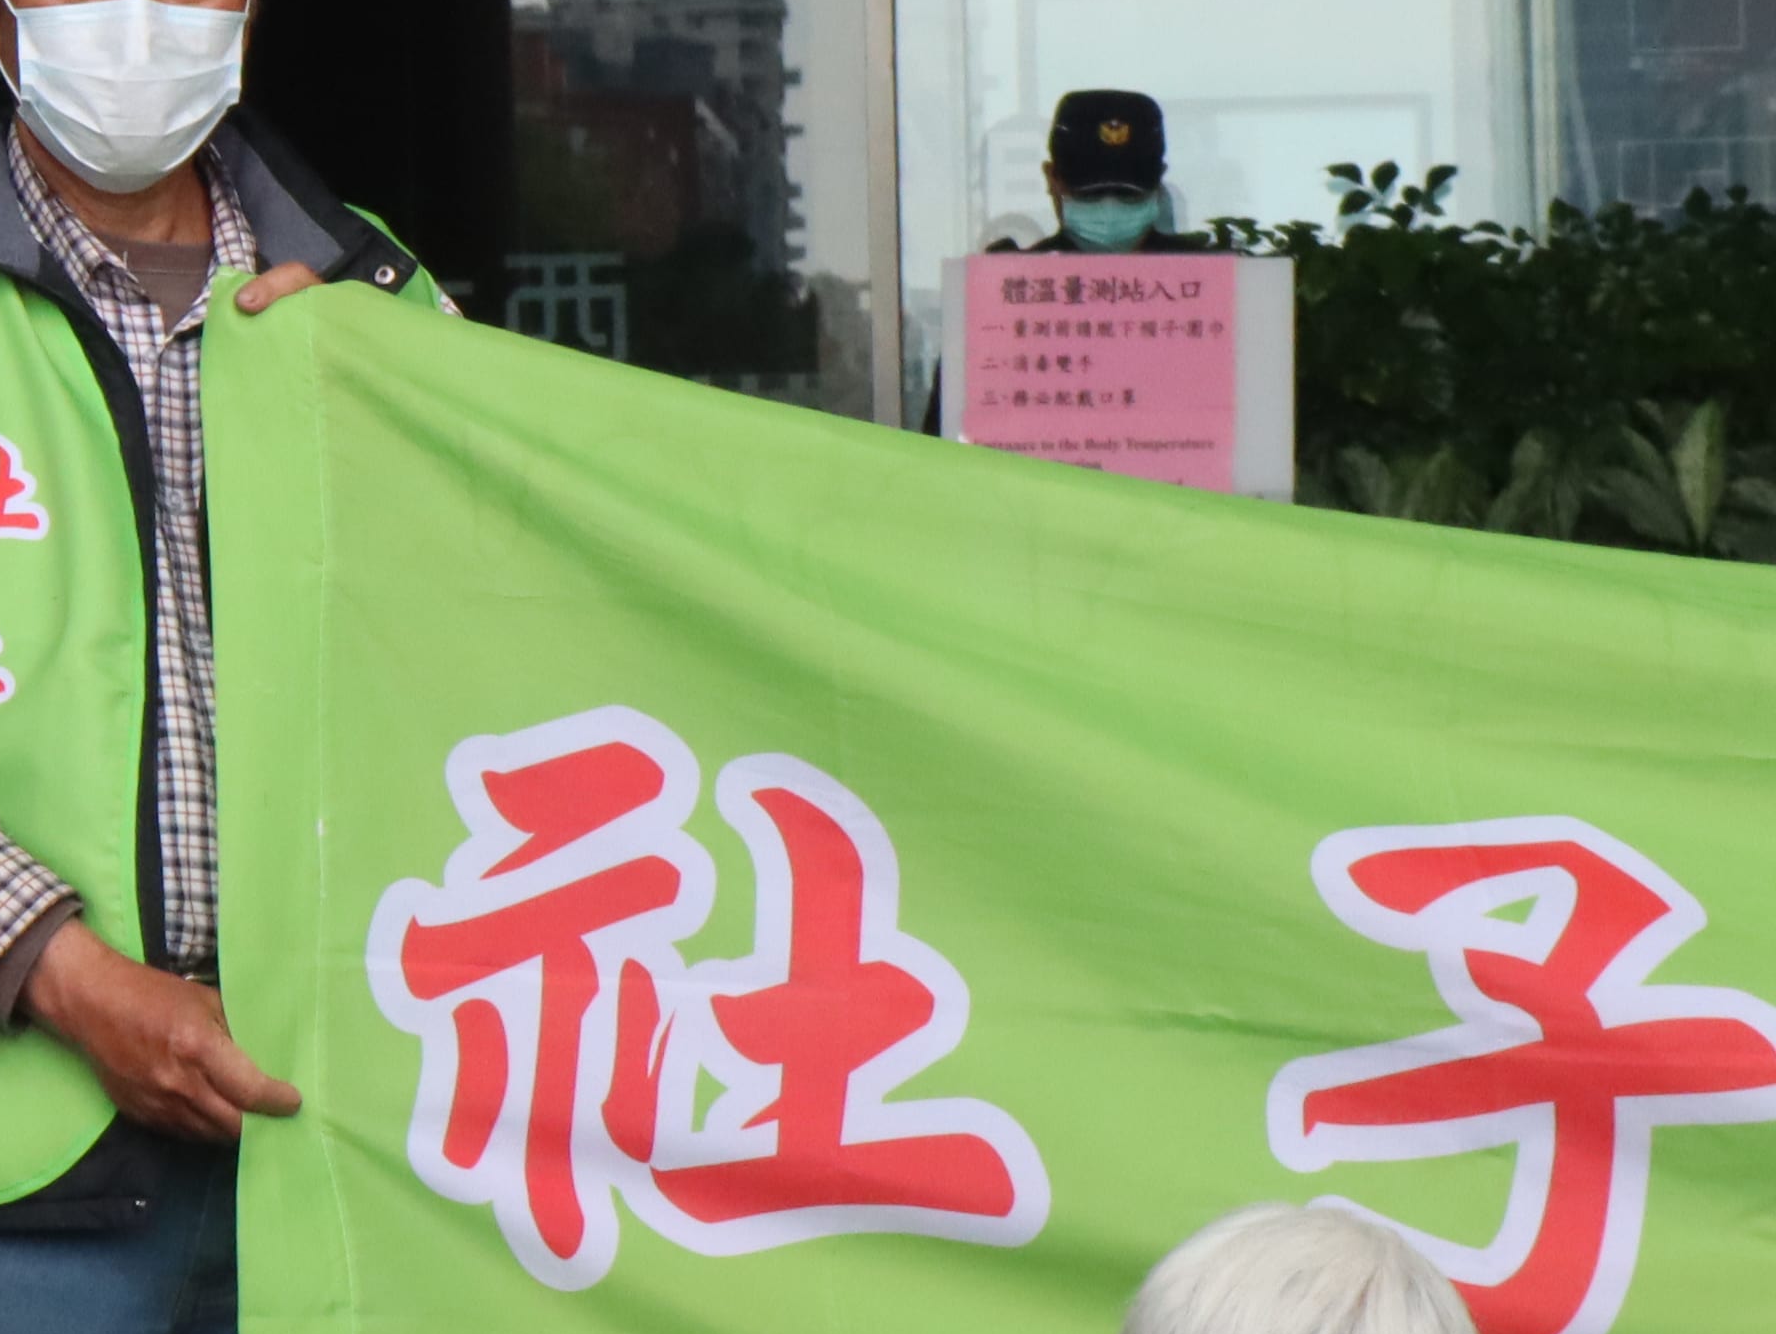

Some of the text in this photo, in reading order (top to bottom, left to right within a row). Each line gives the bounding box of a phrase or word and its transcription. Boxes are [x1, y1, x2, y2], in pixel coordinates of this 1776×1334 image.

[1000, 275, 1202, 305] 體溫量測站入口
